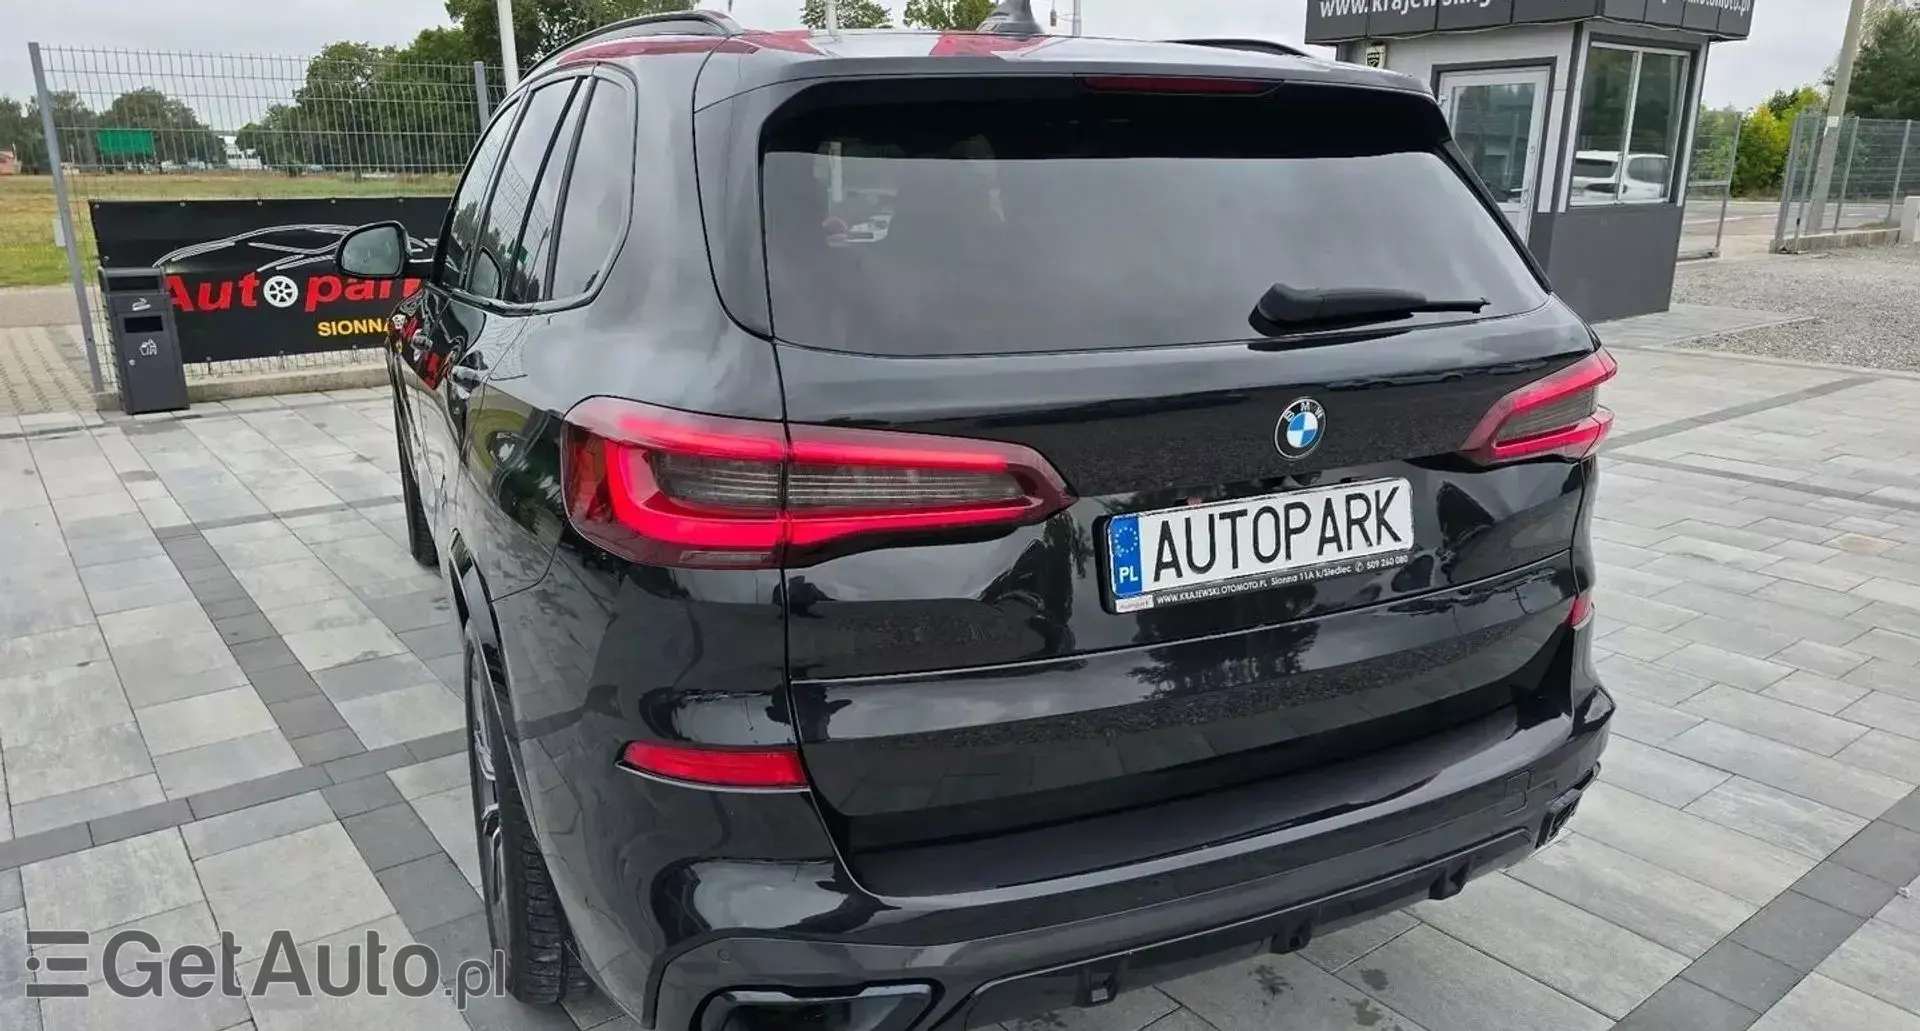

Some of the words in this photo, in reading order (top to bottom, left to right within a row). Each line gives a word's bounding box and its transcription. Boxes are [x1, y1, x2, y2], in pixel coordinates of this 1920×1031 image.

[1283, 401, 1324, 422] BMW
[1153, 485, 1402, 582] AUTOPARK
[1119, 565, 1139, 584] PL
